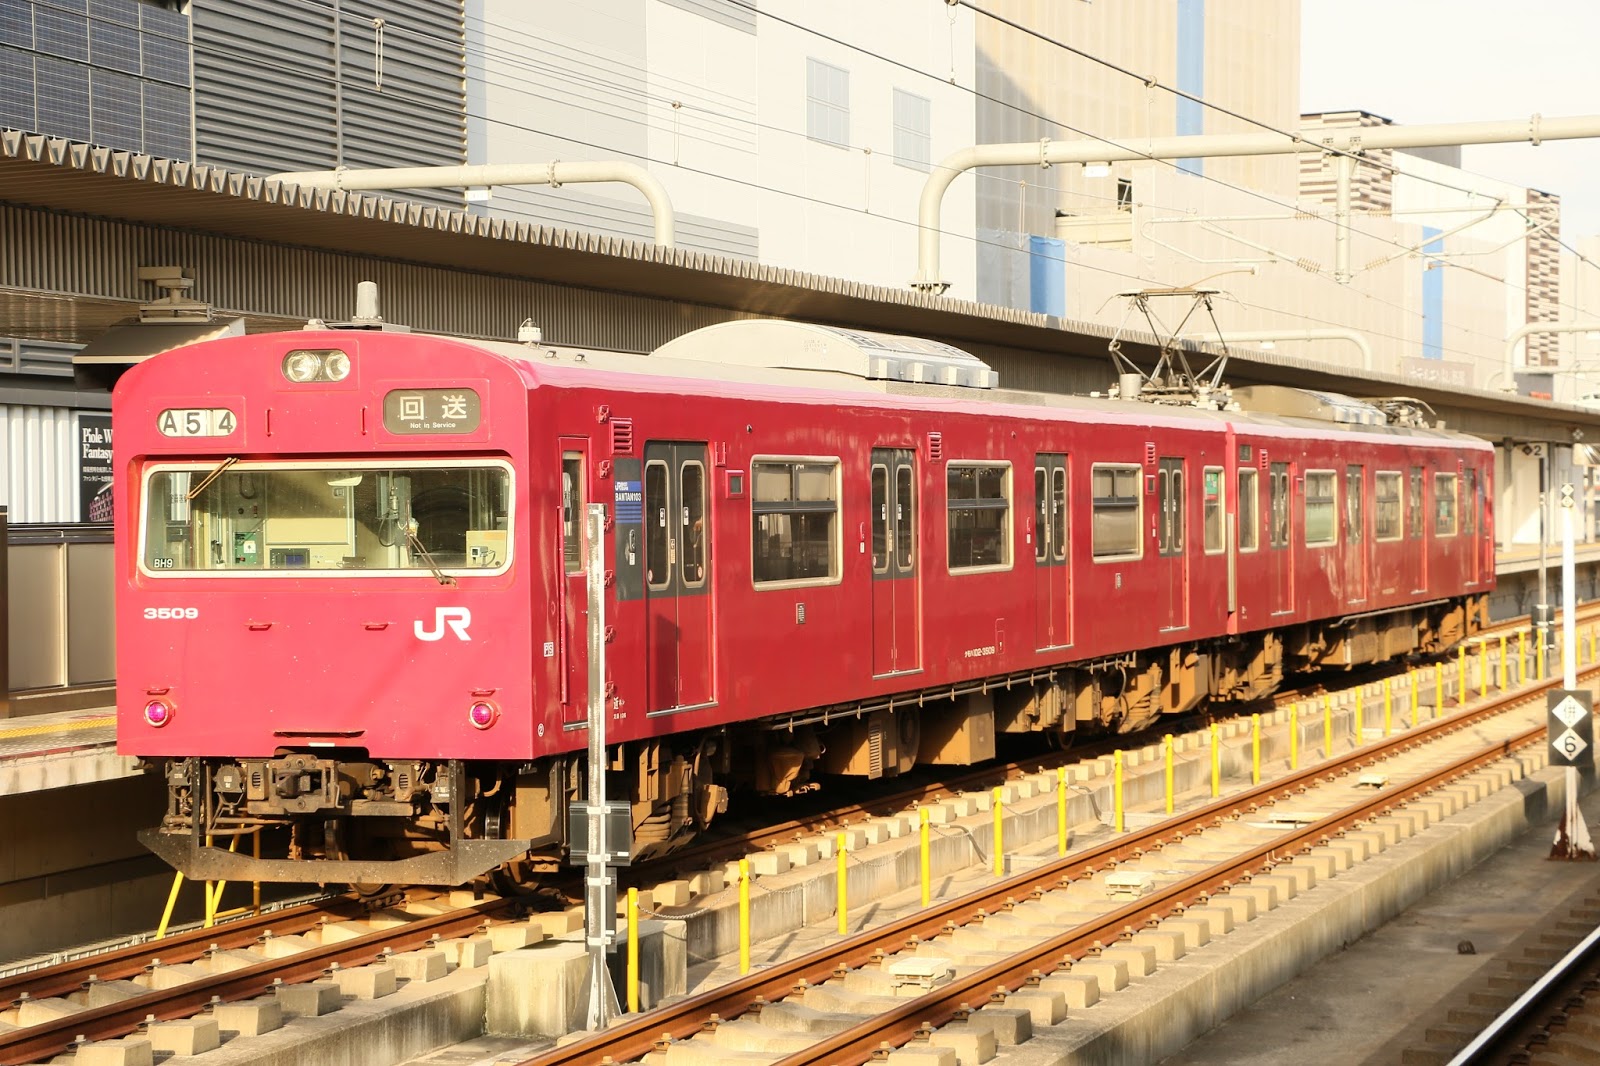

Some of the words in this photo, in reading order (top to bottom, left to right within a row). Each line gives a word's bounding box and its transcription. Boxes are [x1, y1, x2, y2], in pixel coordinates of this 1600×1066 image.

[400, 395, 467, 420] 回送
[82, 428, 103, 443] Piole
[82, 443, 114, 463] Fantasy
[1533, 445, 1541, 456] 2
[154, 558, 173, 568] BH9
[143, 607, 199, 620] 3509
[413, 606, 472, 641] JR
[1564, 735, 1577, 753] 6
